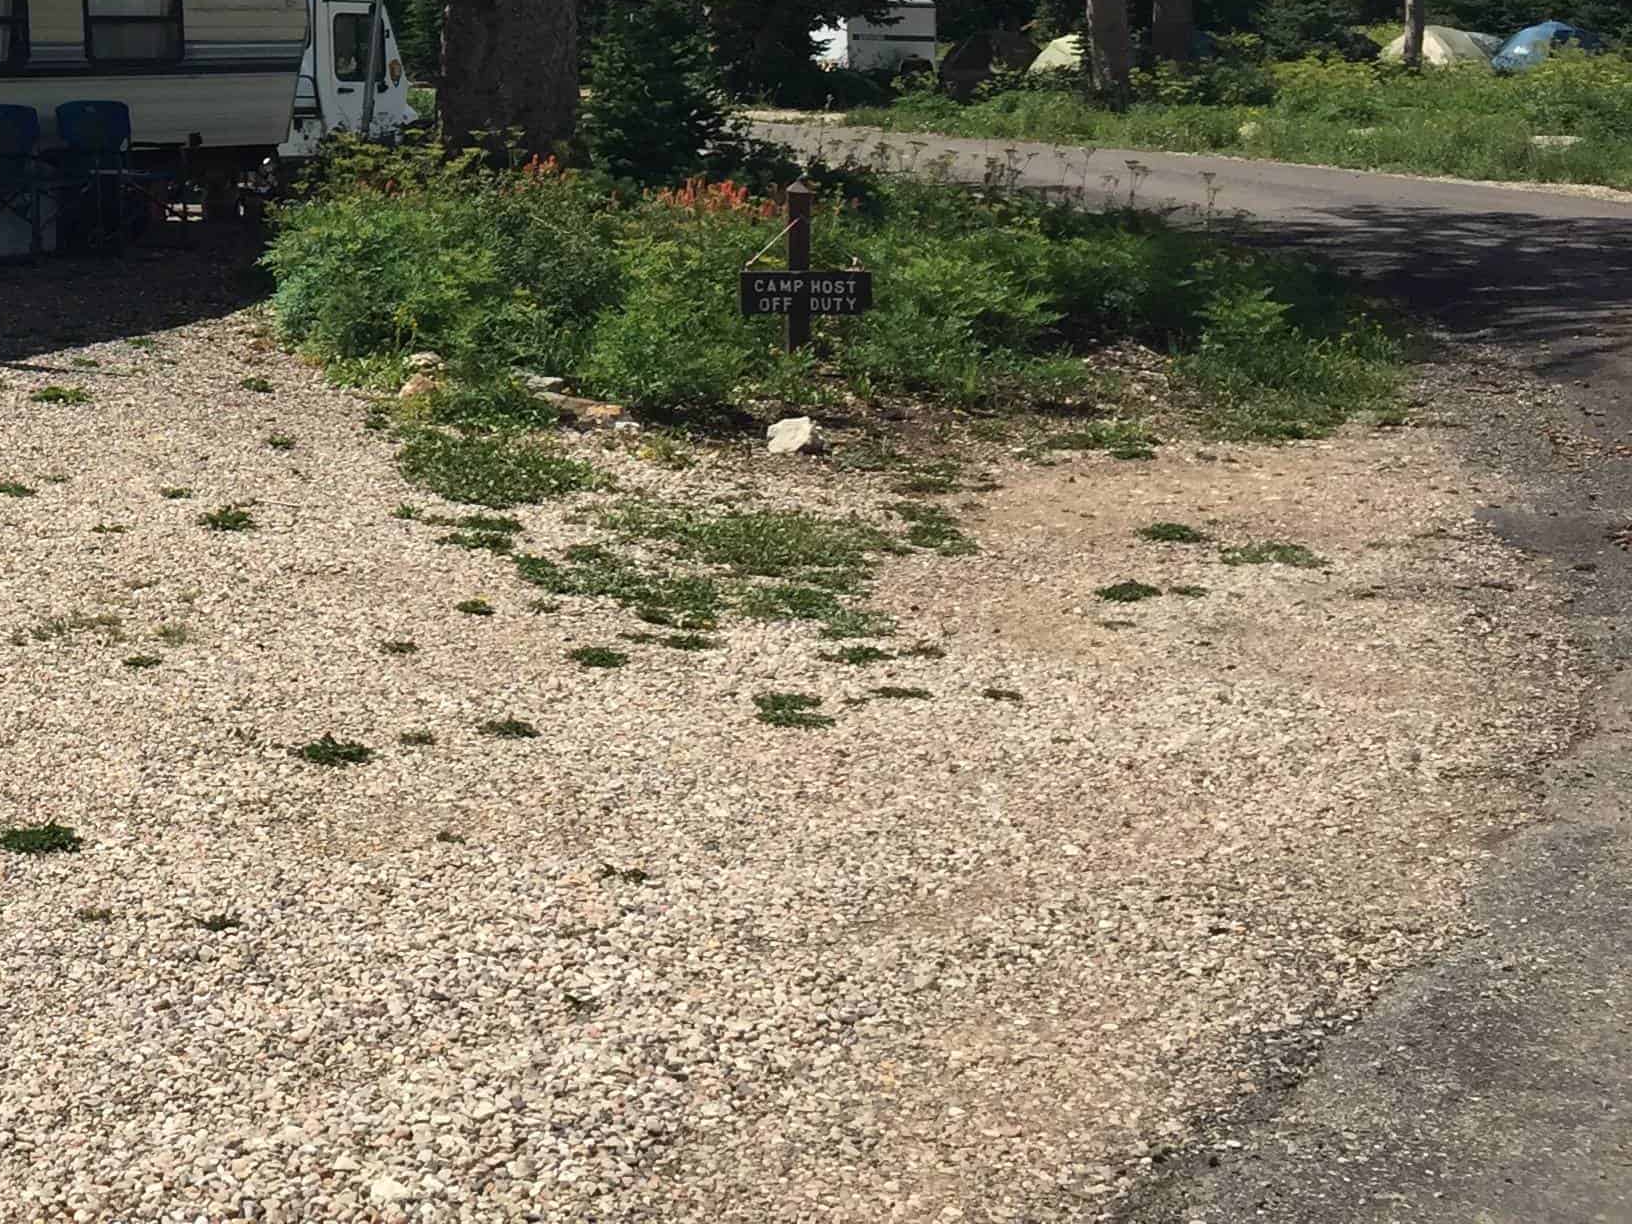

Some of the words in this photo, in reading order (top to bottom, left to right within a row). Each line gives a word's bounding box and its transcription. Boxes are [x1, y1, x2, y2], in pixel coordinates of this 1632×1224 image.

[754, 279, 804, 293] CAMP
[810, 279, 857, 294] HOST
[759, 297, 793, 312] OFF
[810, 297, 857, 311] DUTY
